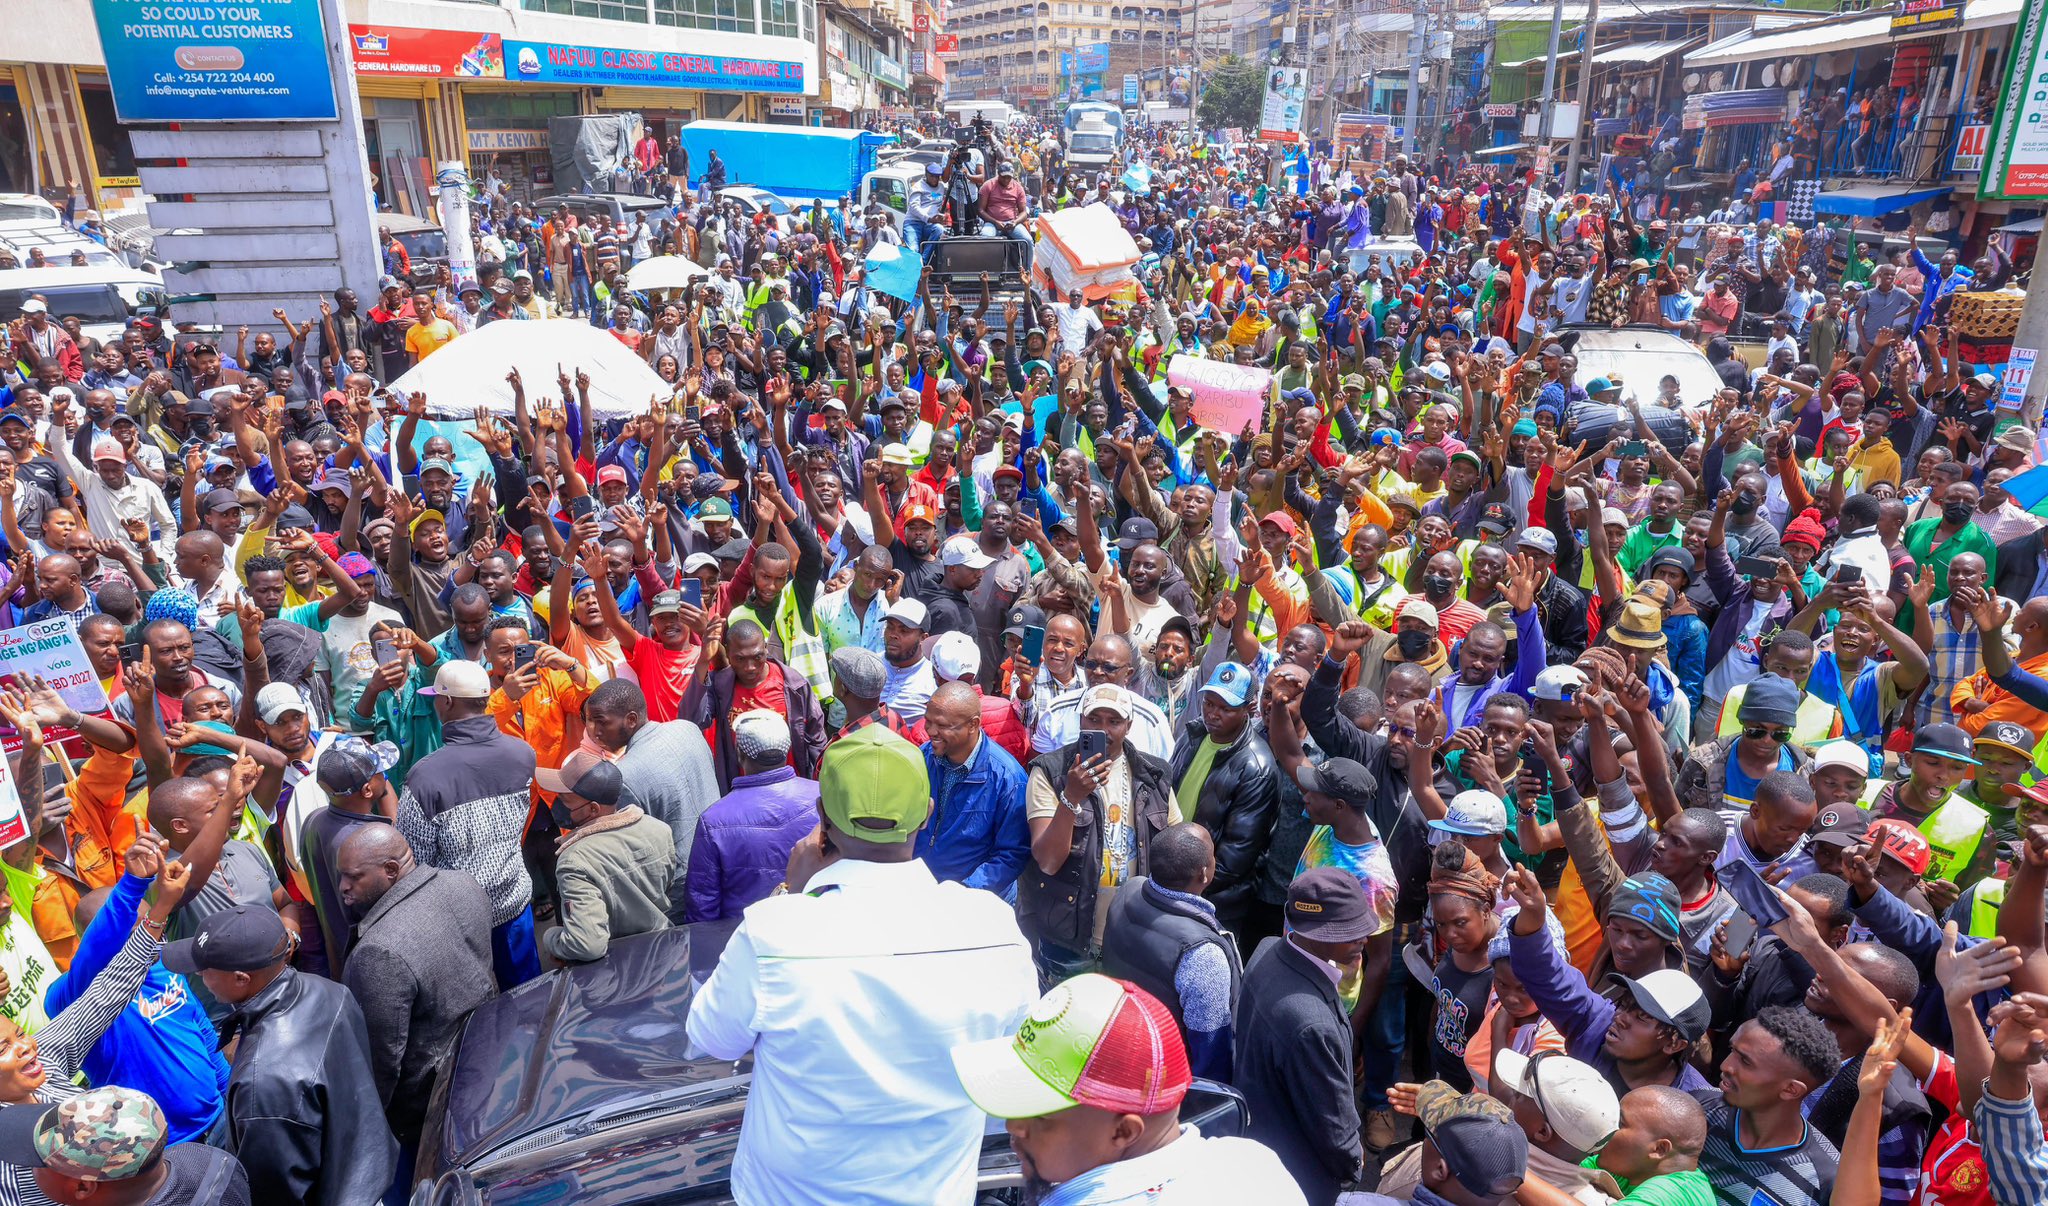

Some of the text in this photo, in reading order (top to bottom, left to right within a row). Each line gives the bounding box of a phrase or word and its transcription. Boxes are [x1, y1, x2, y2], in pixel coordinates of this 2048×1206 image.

[142, 7, 262, 22] SO COULD YOUR
[124, 25, 293, 39] POTENTIAL CUSTOMERS
[357, 61, 389, 71] GENERAL
[390, 63, 427, 73] HARDWARE
[429, 64, 441, 73] LTD
[547, 45, 804, 80] NAFUU CLASSIC GENERAL HARDWARE LTD
[154, 73, 275, 83] Cell: +254 722 204 400
[554, 69, 582, 78] DEALERS
[145, 85, 290, 98] info@magnate-ventures.com
[773, 97, 801, 105] HOTEL
[497, 133, 535, 148] KENYA
[2010, 369, 2024, 384] 11
[1195, 387, 1245, 409] KARIBU
[42, 621, 66, 634] DCP
[69, 671, 92, 685] 2027
